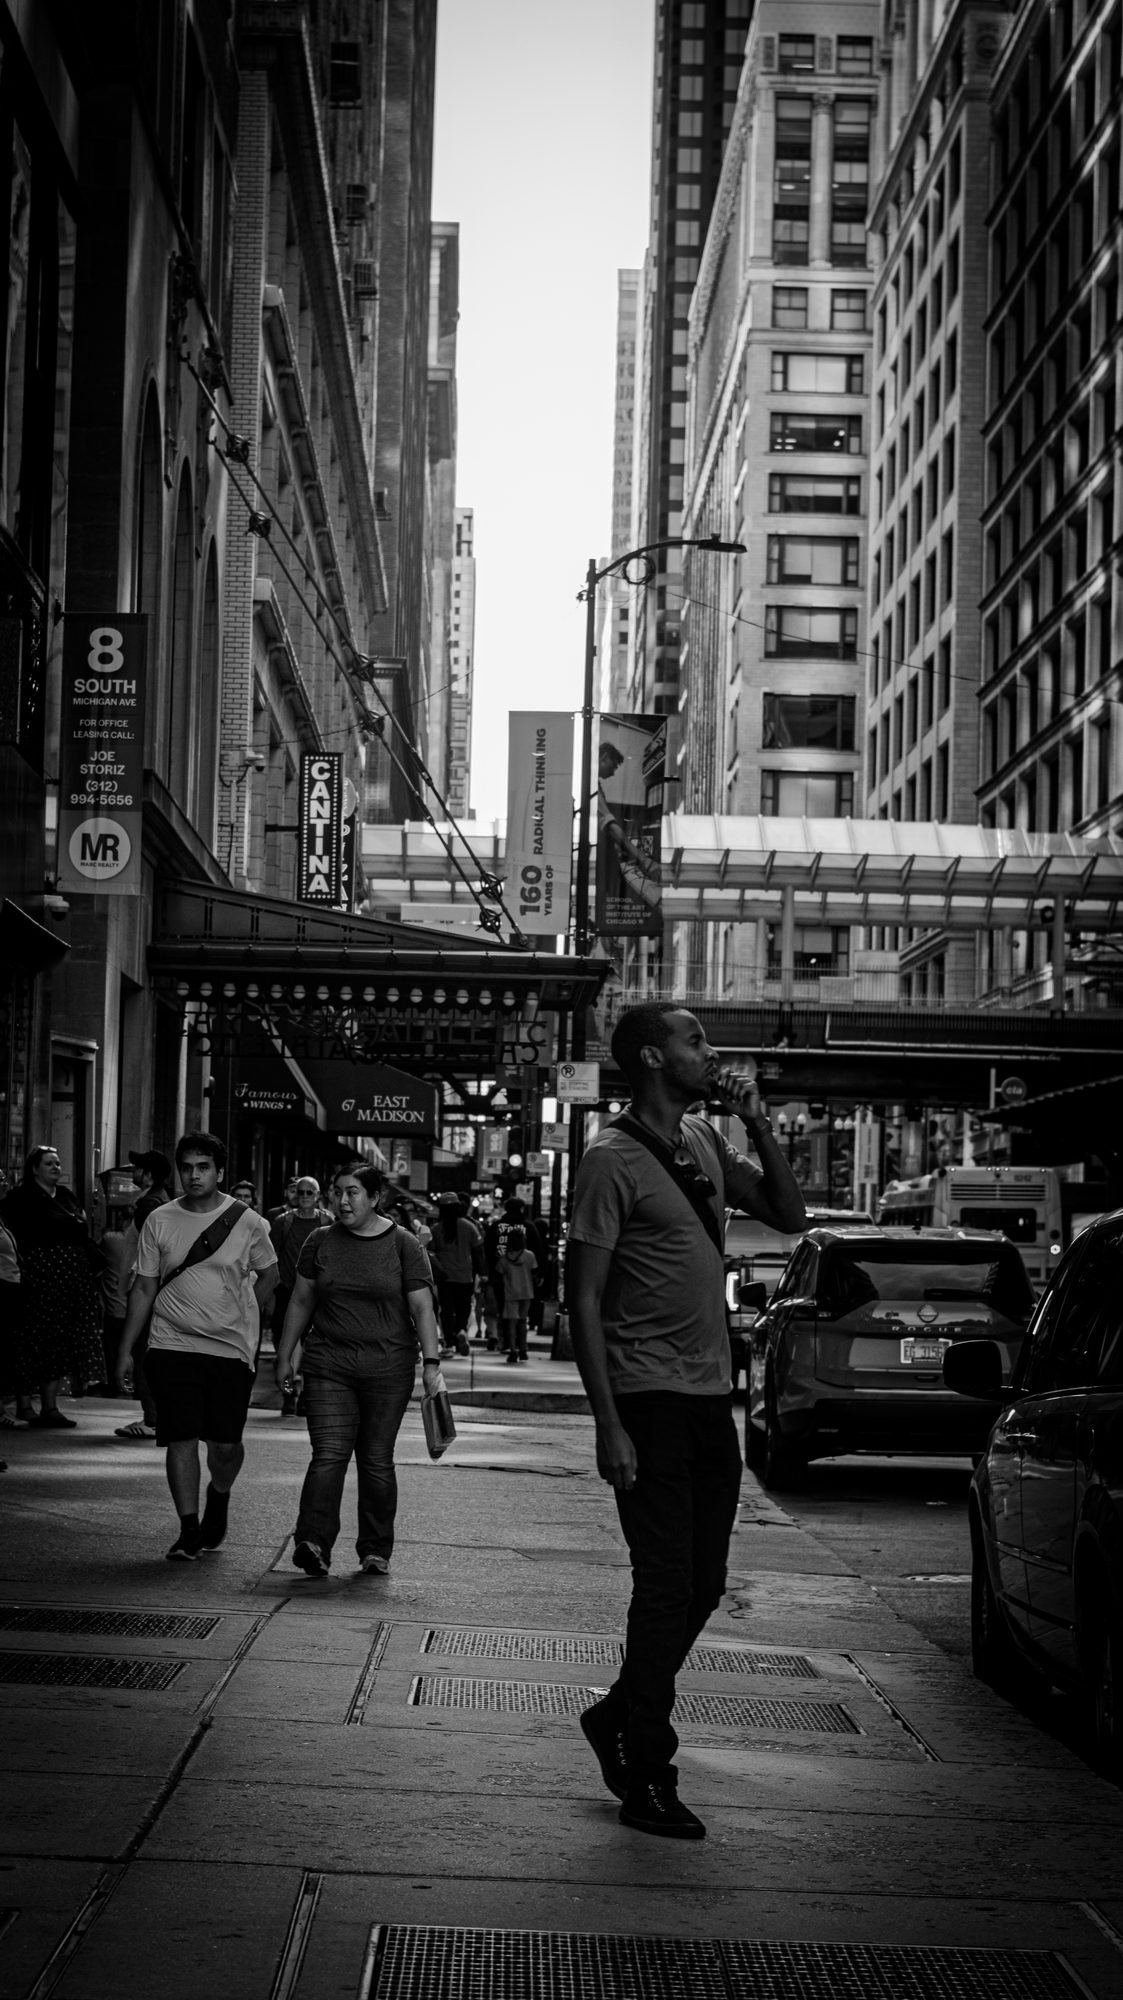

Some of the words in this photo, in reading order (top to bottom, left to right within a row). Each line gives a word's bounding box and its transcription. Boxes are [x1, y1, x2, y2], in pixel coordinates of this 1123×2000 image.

[87, 627, 124, 673] 8
[73, 679, 136, 694] SOUTH
[73, 698, 117, 706] MICHIGAN
[119, 699, 136, 707] AVE
[80, 719, 96, 728] FOR
[98, 720, 128, 728] OFFICE
[73, 731, 109, 739] LEASING
[111, 732, 134, 740] CALL:
[90, 751, 116, 762] JOE
[535, 728, 546, 792] THINKING
[80, 764, 126, 775] STORIZ
[86, 780, 118, 792] (312)
[70, 794, 133, 806] 994-5656
[308, 761, 332, 893] CANTINA
[533, 796, 545, 855] RADICAL
[81, 833, 120, 862] MR
[545, 864, 553, 879] OF
[520, 865, 542, 916] 160
[544, 881, 553, 916] YEARS
[235, 1083, 299, 1101] Famous
[250, 1100, 285, 1110] WINGS
[341, 1099, 356, 1111] 67
[373, 1095, 410, 1109] EAST
[357, 1109, 425, 1123] MADISON
